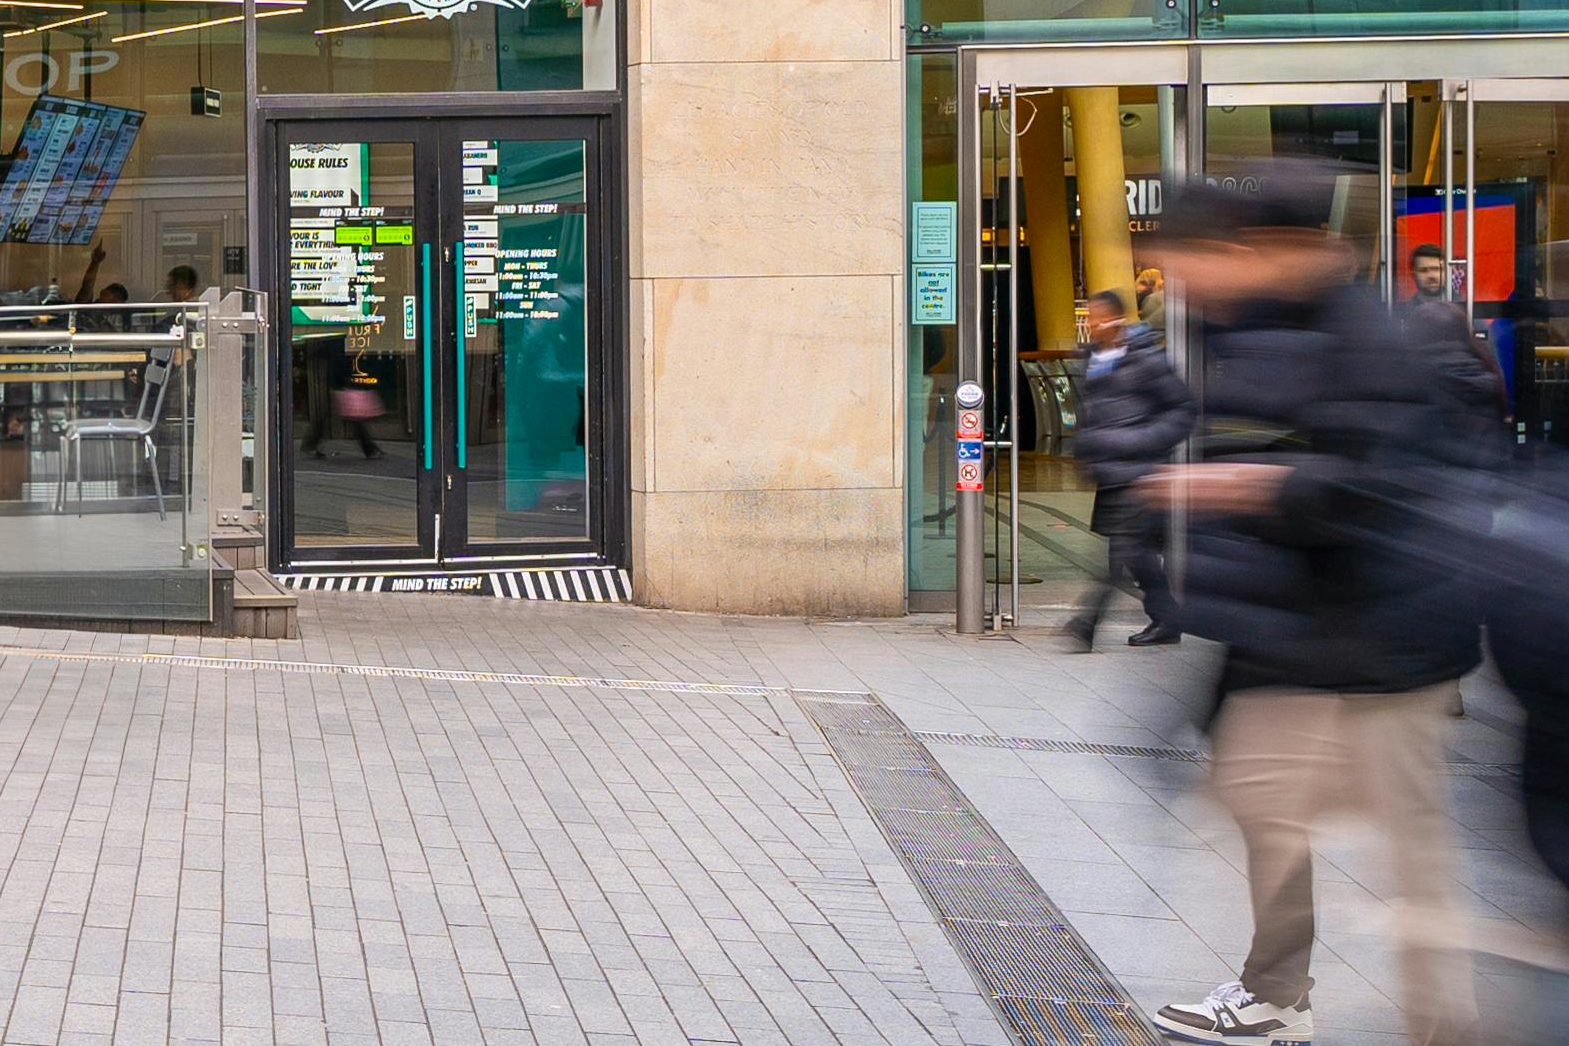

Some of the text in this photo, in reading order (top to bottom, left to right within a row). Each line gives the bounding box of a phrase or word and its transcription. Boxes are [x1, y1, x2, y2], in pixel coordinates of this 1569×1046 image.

[290, 158, 349, 169] OUSE RULES
[310, 190, 345, 199] FLAVOUR
[318, 206, 385, 217] MIND THE STEP!
[493, 203, 558, 214] MIND THE STEP!
[495, 248, 558, 259] OPENING HOURS
[300, 283, 322, 291] TIGHT
[391, 576, 483, 591] MIND THE STEP!
